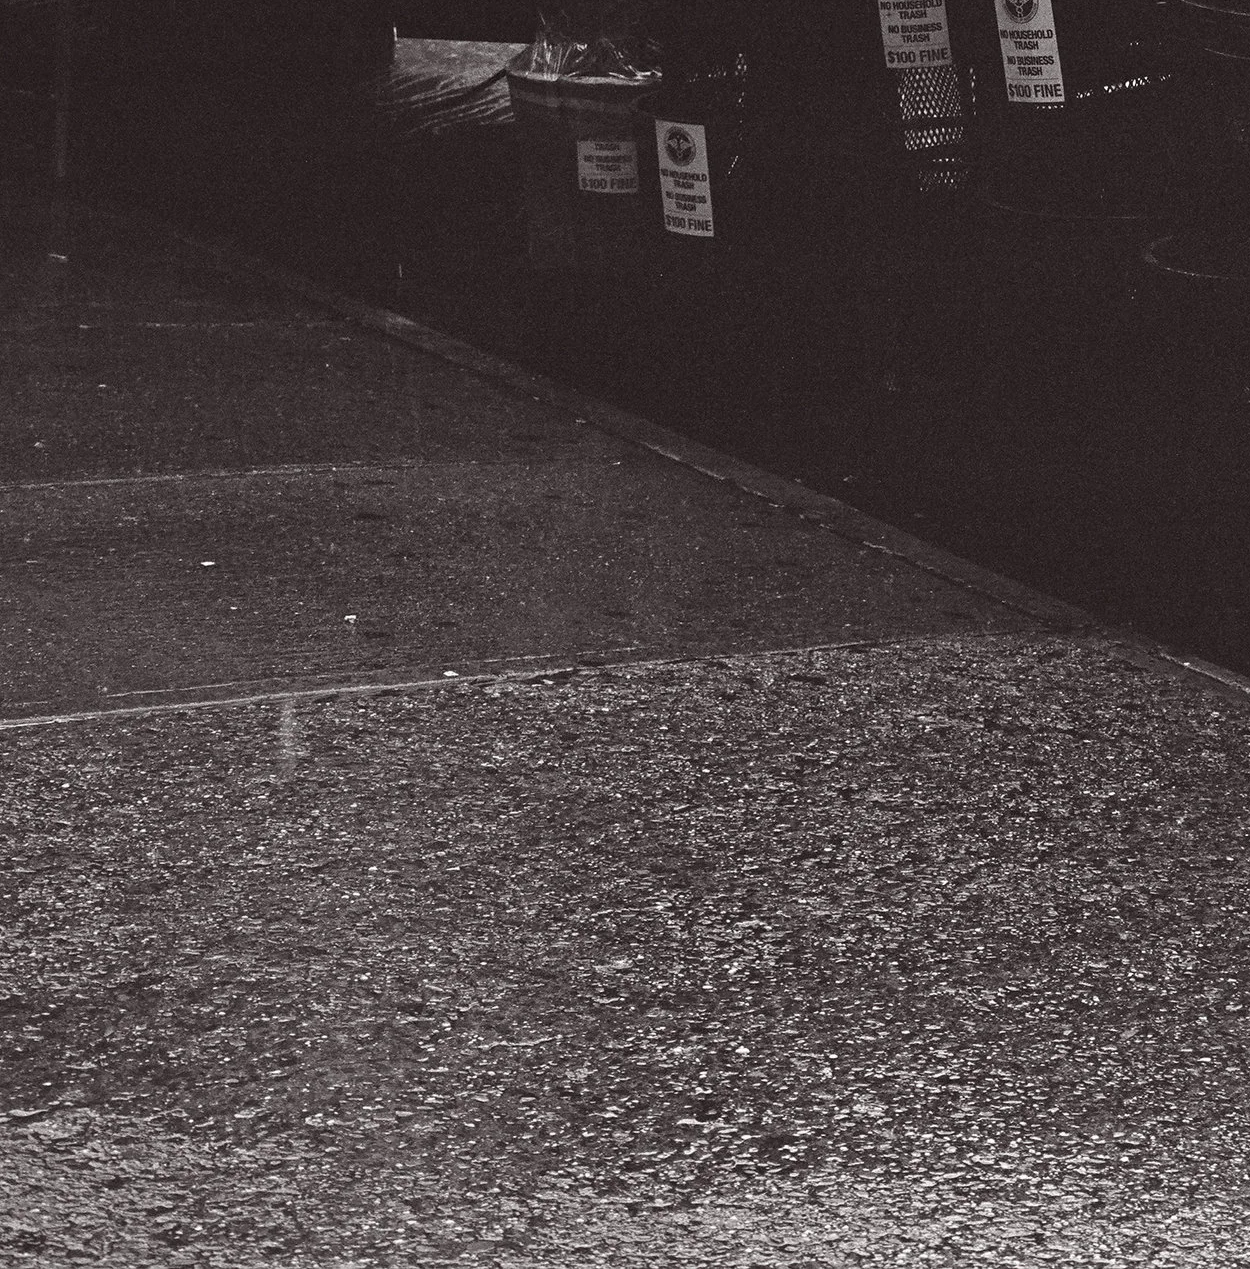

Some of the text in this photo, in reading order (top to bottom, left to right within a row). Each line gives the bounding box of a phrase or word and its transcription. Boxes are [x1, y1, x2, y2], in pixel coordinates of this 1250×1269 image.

[880, 1, 891, 10] NO
[898, 10, 927, 19] TRASH
[888, 22, 942, 33] NO BUSINESS
[902, 34, 930, 43] TRASH
[1000, 29, 1053, 39] NO HOUSEHOLD
[1014, 41, 1038, 50] TRASH
[888, 48, 948, 64] $100 FINE
[1007, 56, 1054, 65] NO BUSINESS
[1017, 66, 1042, 75] TRASH
[1009, 83, 1062, 98] $100 FINE
[669, 172, 707, 182] HOUSEHOLD
[674, 180, 694, 189] TRASH
[666, 191, 706, 203] NO BUSINESS
[676, 202, 696, 211] TRASH
[666, 215, 712, 231] $100 FINE
